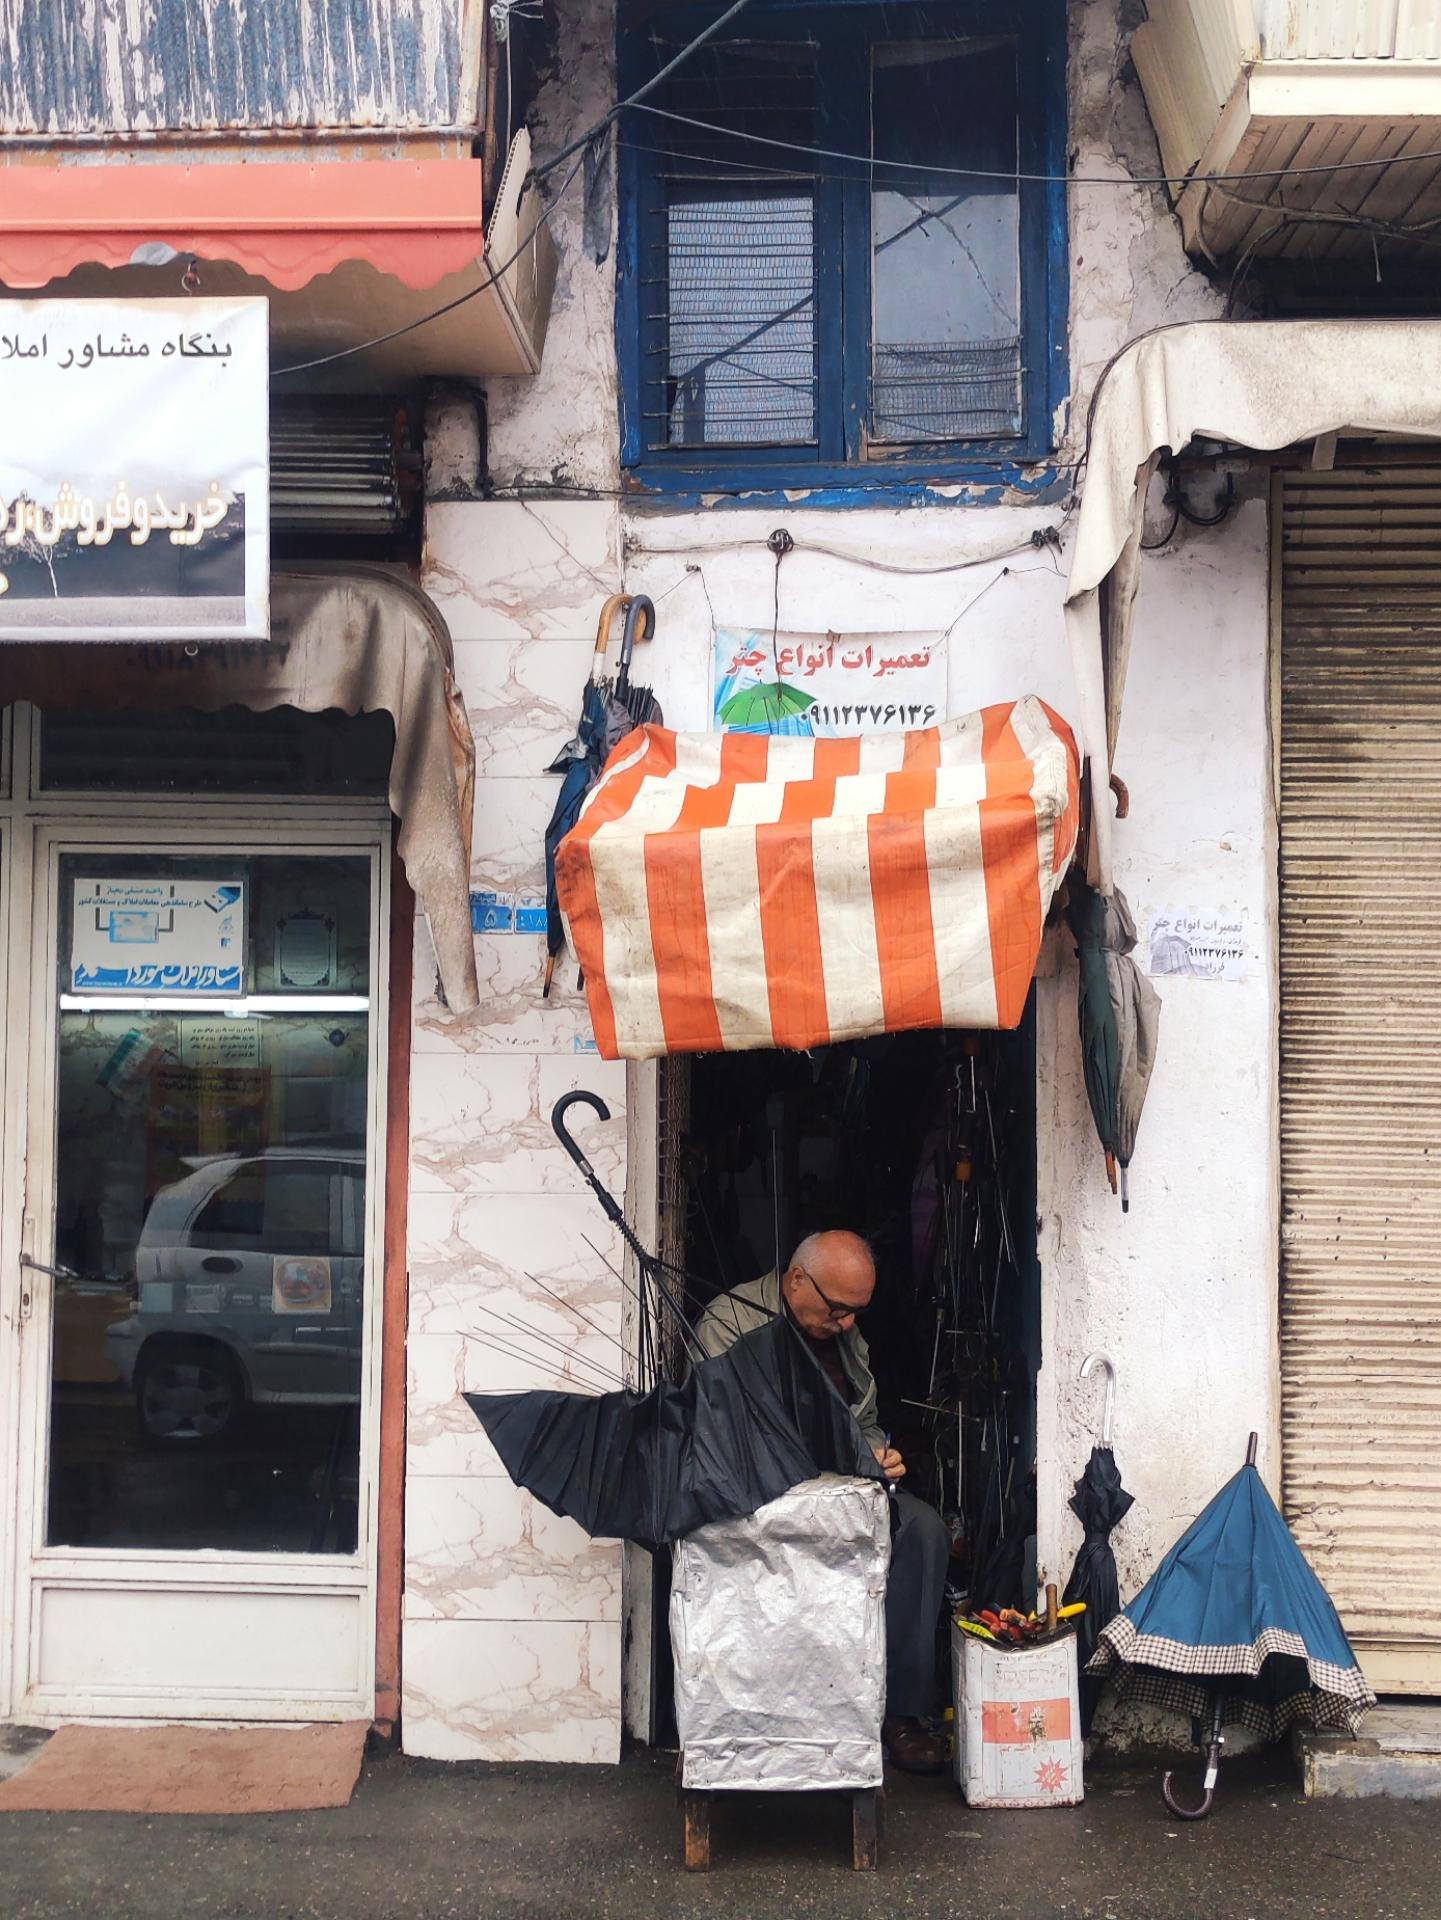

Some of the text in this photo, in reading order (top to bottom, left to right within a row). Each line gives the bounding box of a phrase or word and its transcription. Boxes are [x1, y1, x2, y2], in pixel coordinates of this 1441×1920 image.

[0, 333, 232, 369] بنگاه مشاور املا
[725, 643, 932, 677] تعمیرات انواع چتر
[800, 703, 936, 726] ۰۹۱۱۲۳۷۶۱۳۶
[1174, 918, 1200, 934] انواع
[1203, 919, 1243, 935] تعمیرات
